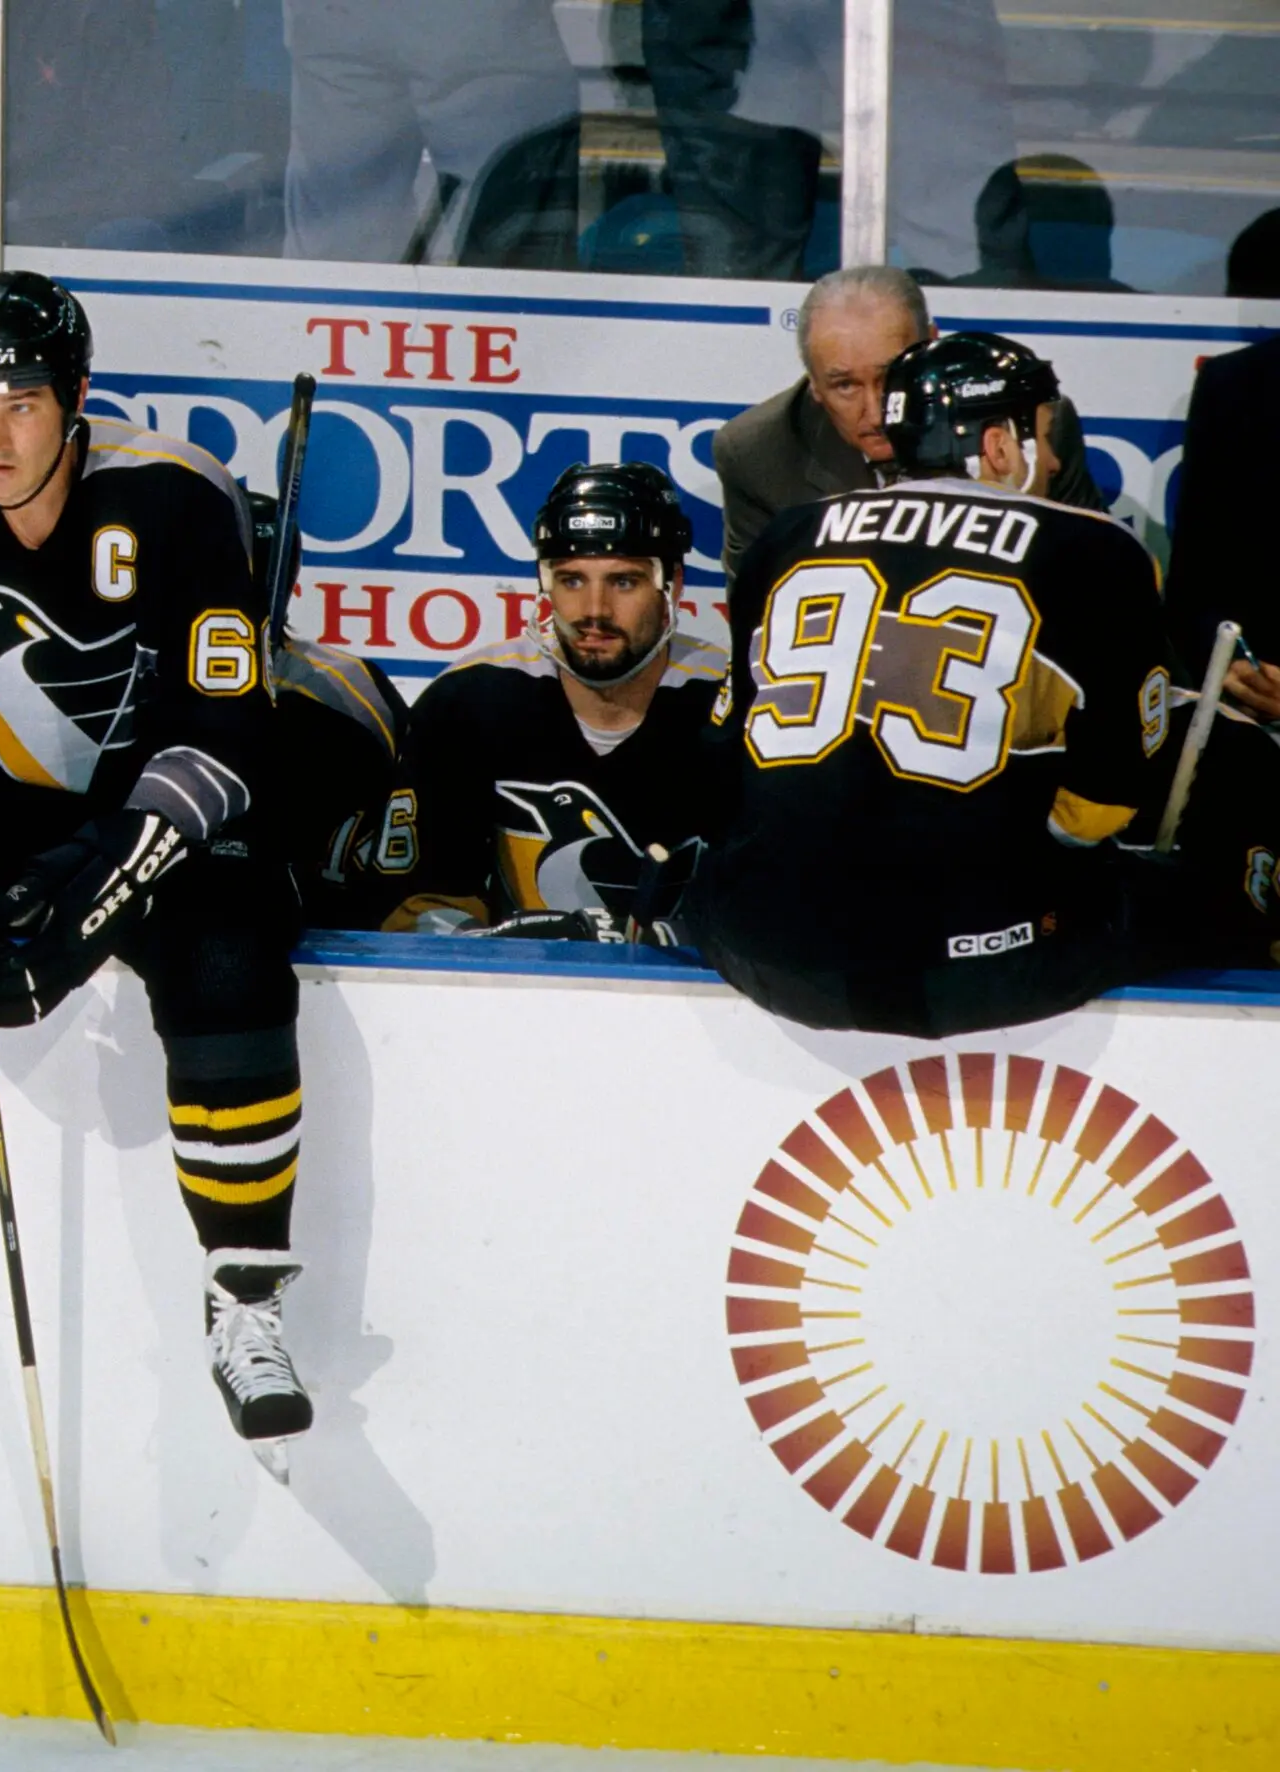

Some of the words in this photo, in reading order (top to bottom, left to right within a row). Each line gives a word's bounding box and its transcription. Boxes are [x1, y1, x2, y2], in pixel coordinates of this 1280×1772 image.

[307, 317, 521, 384] THE
[92, 525, 137, 601] C
[815, 499, 1039, 563] NEDVED
[188, 609, 276, 708] 6
[744, 558, 1042, 793] 93
[81, 826, 180, 938] KOHO
[948, 922, 1033, 957] CCM
